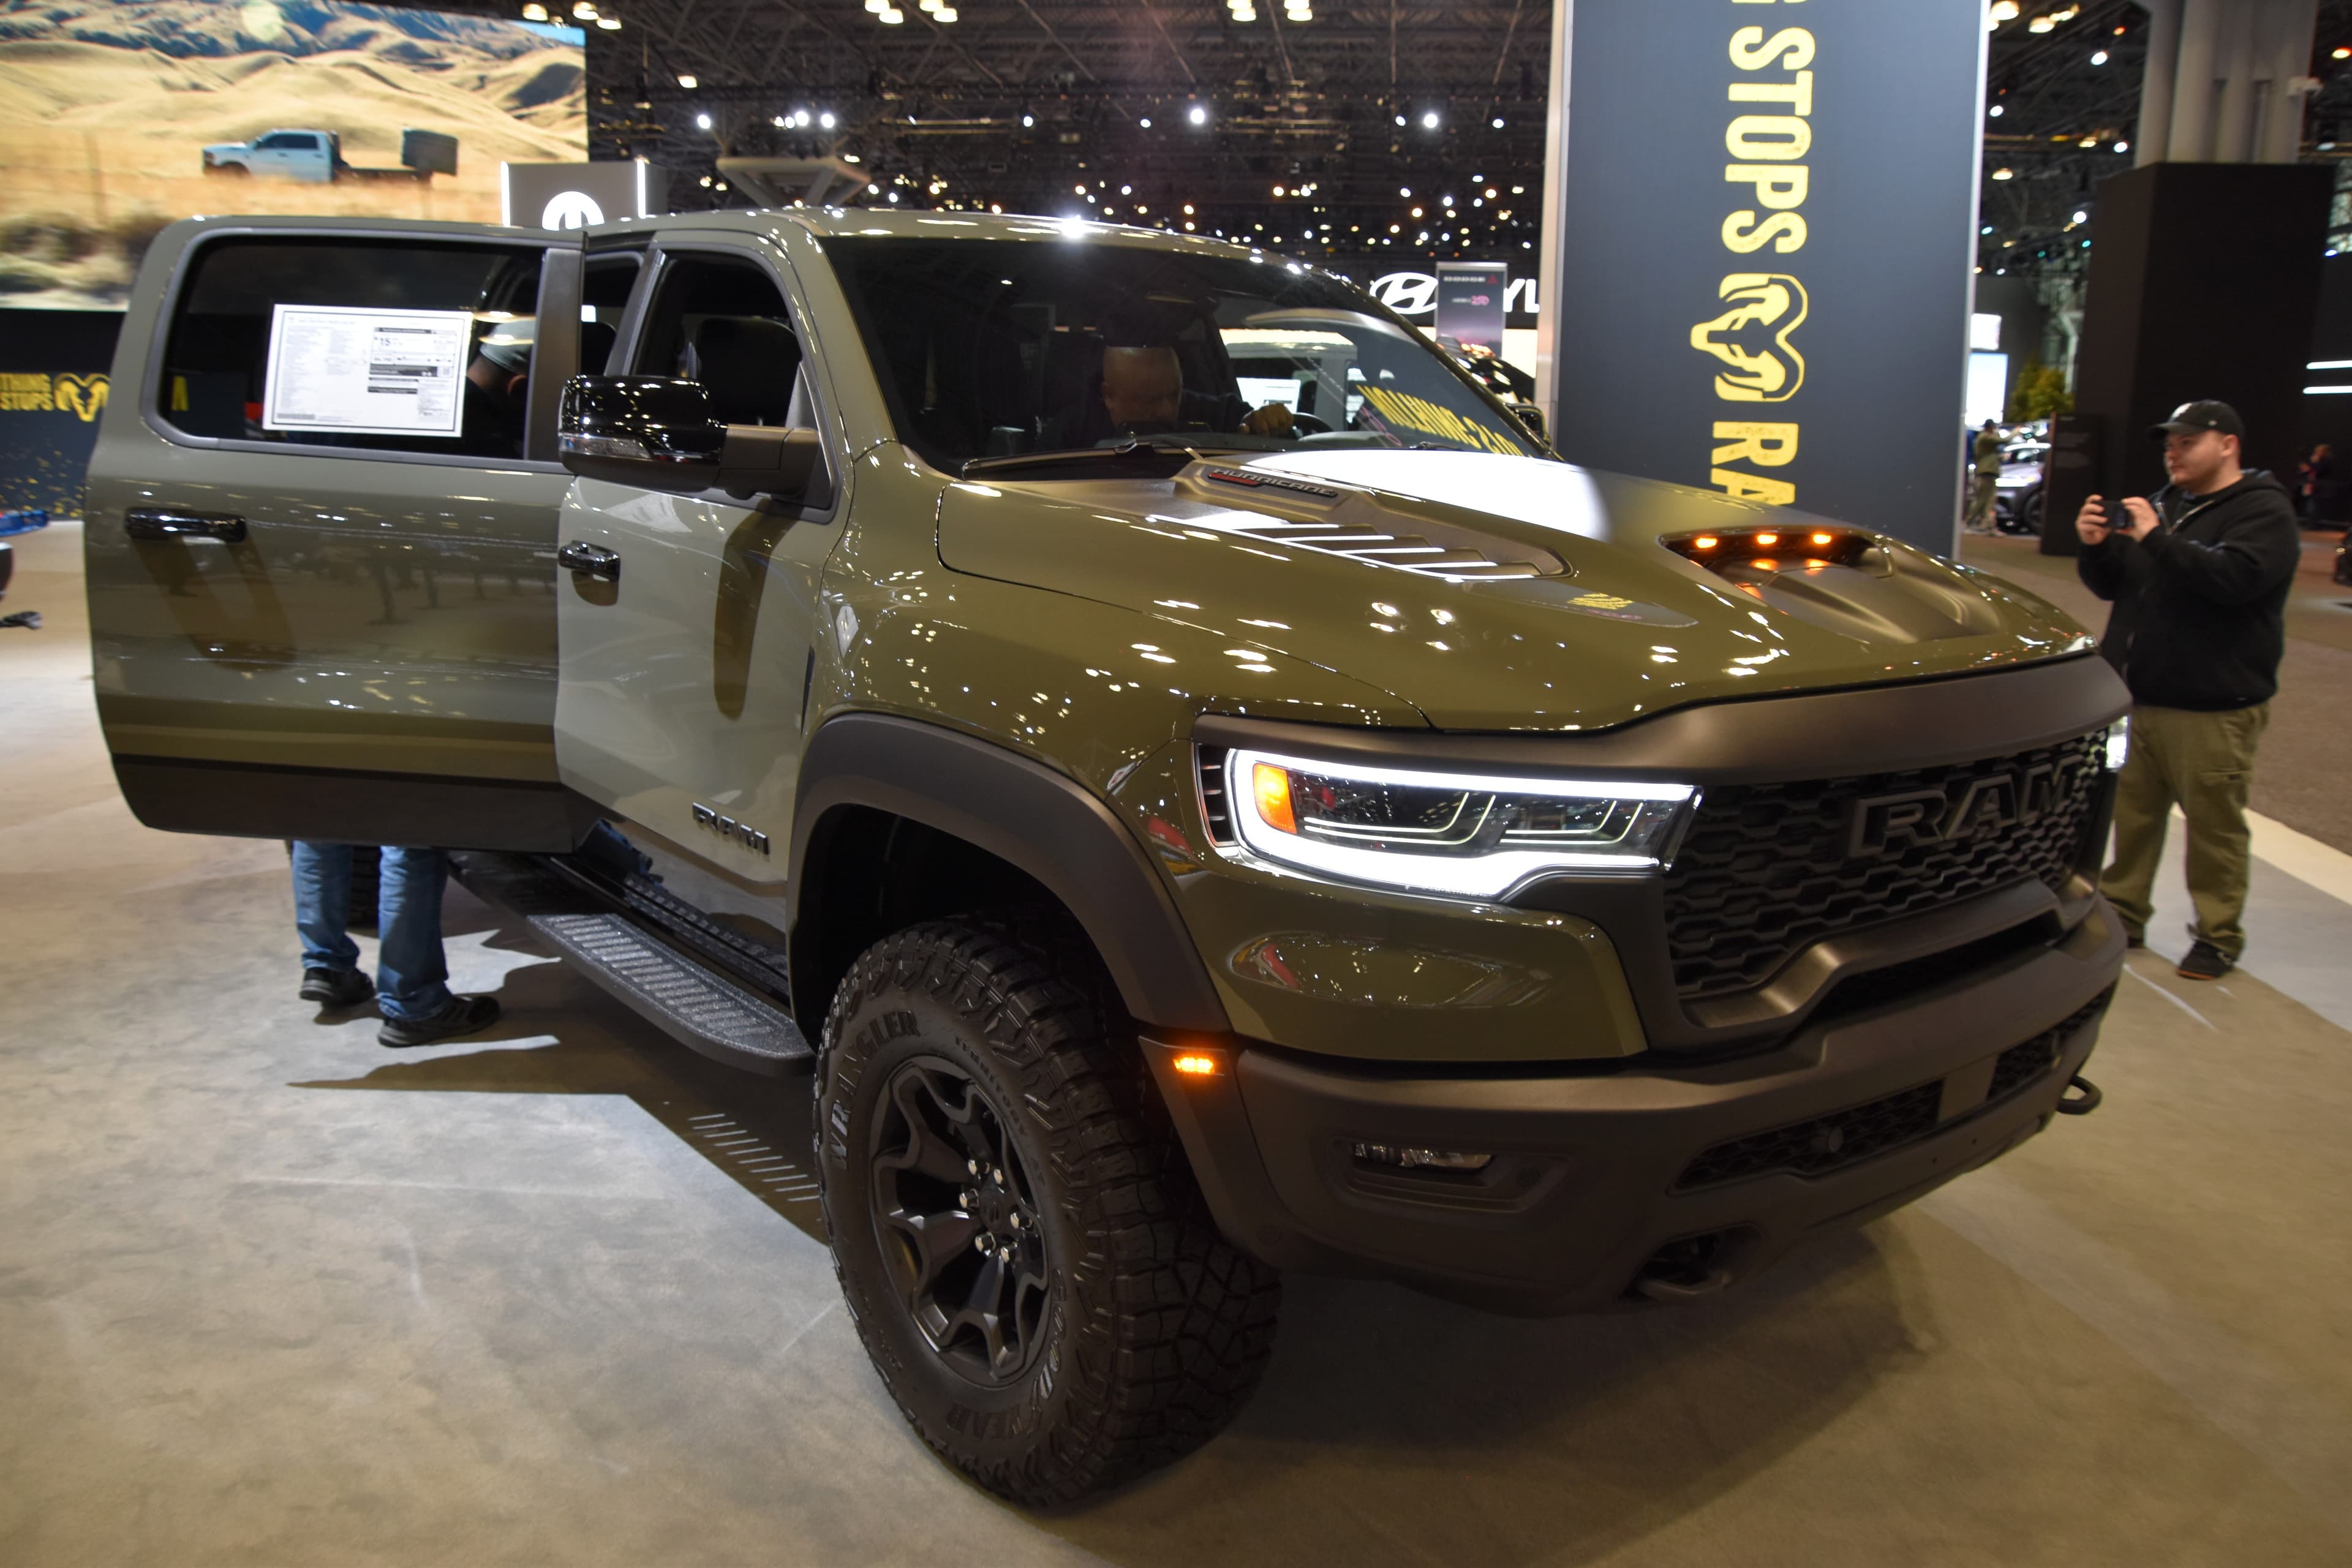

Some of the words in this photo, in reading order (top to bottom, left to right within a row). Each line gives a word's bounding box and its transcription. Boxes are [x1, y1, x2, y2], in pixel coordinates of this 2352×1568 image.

[1721, 26, 1815, 253] STOPS
[0, 392, 54, 411] STOPS
[1213, 468, 1334, 495] HURRICANE
[1711, 421, 1799, 506] RA
[692, 802, 770, 856] RAM
[1849, 754, 2084, 858] RAM
